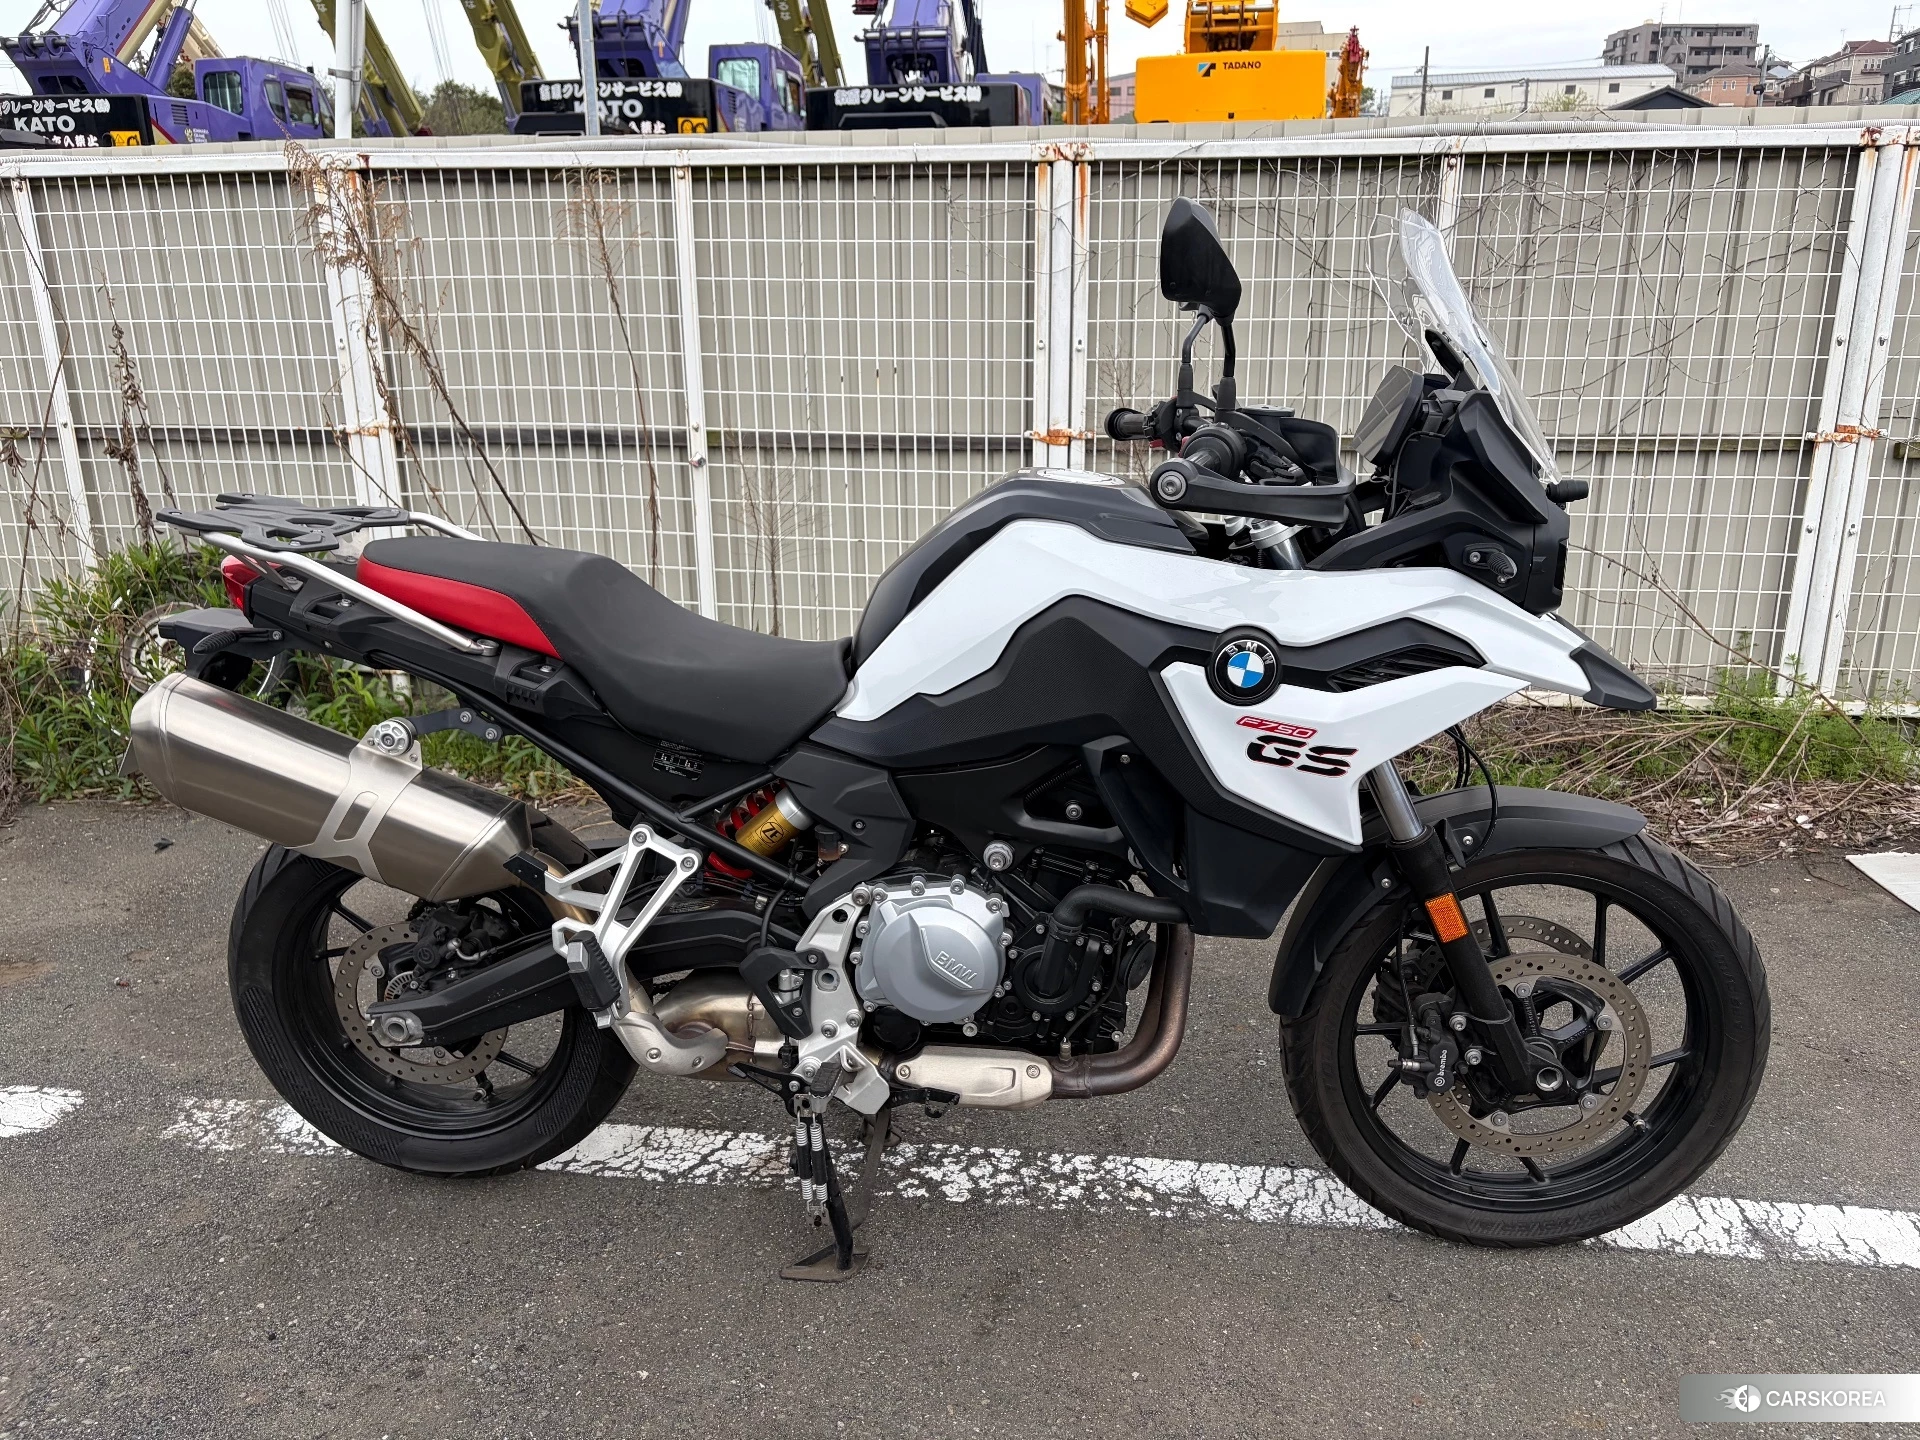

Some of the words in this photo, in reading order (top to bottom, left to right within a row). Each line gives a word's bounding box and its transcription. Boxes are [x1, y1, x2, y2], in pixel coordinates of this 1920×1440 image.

[1223, 61, 1262, 70] TADANO
[14, 115, 76, 132] KATO
[1225, 641, 1275, 665] BMW
[1239, 716, 1313, 738] F750
[1246, 734, 1359, 777] GS
[762, 822, 784, 844] ZF
[935, 951, 977, 982] BMW
[1437, 1049, 1448, 1076] brembo
